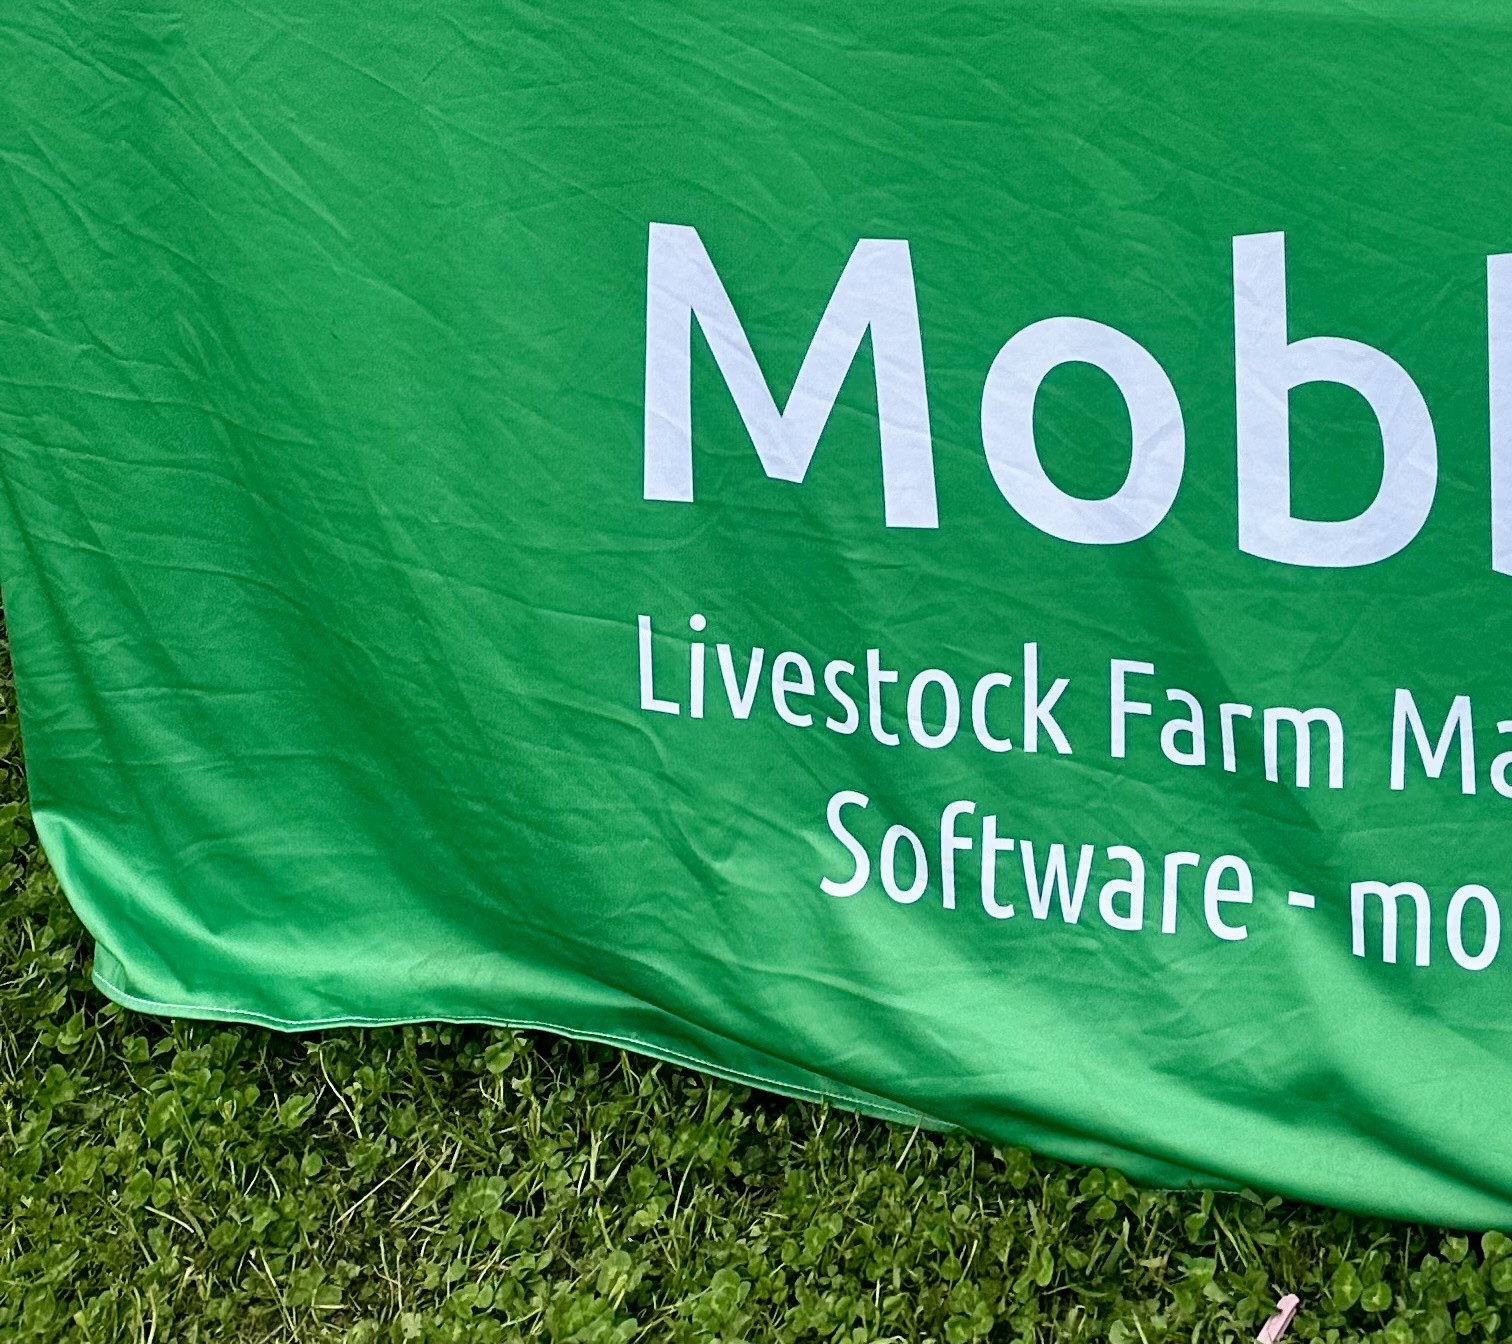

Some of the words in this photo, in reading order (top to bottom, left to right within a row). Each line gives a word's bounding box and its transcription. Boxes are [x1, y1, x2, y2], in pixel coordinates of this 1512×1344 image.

[637, 613, 1073, 755] Livestock
[1110, 658, 1344, 789] Farm
[819, 790, 1254, 941] Software
